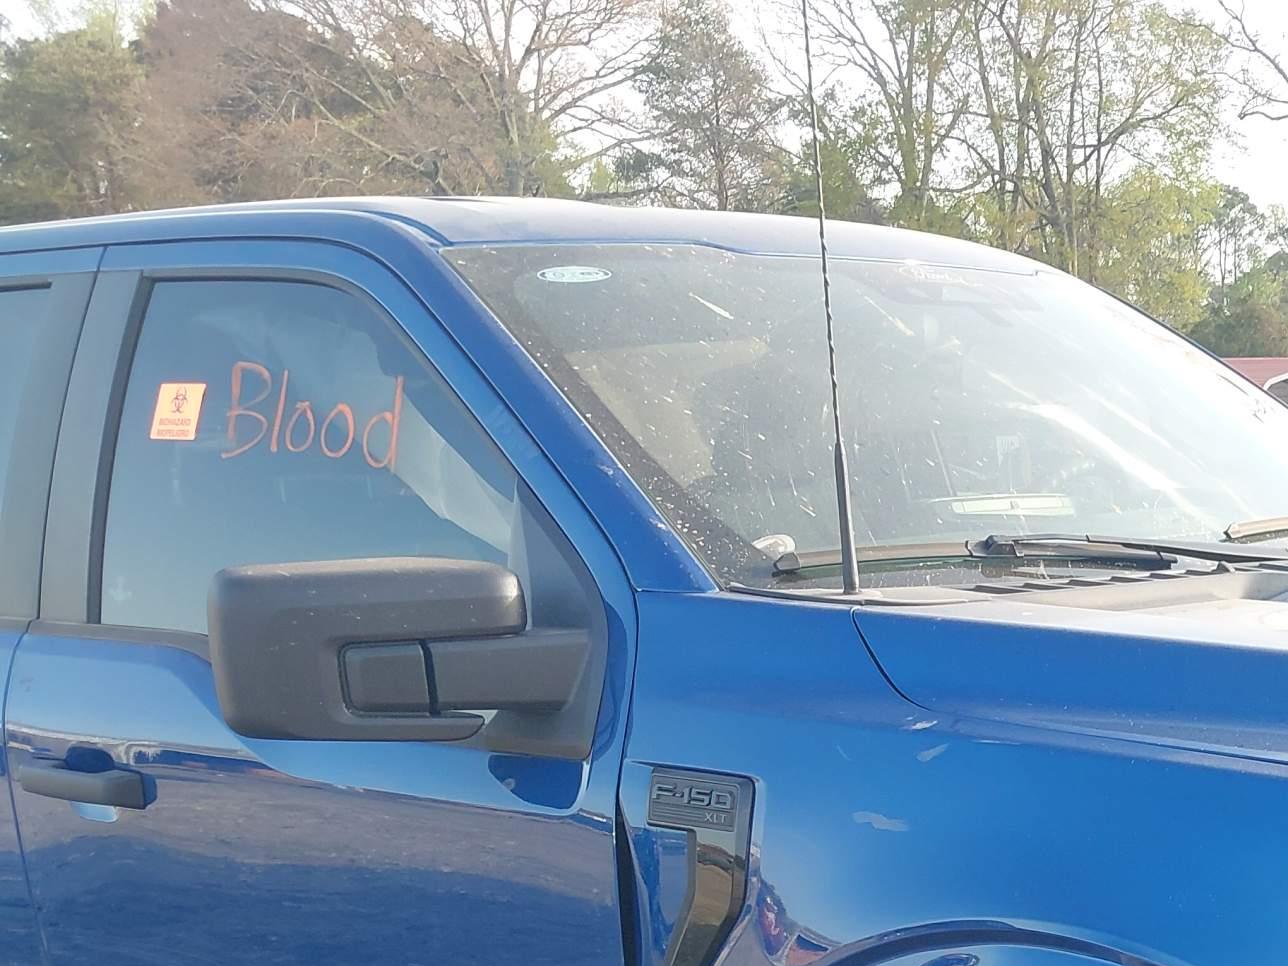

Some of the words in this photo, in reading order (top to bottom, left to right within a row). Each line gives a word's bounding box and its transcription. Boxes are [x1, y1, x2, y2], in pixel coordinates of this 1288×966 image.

[220, 361, 404, 473] Blood
[652, 783, 733, 809] F-150
[704, 812, 728, 824] XLT
